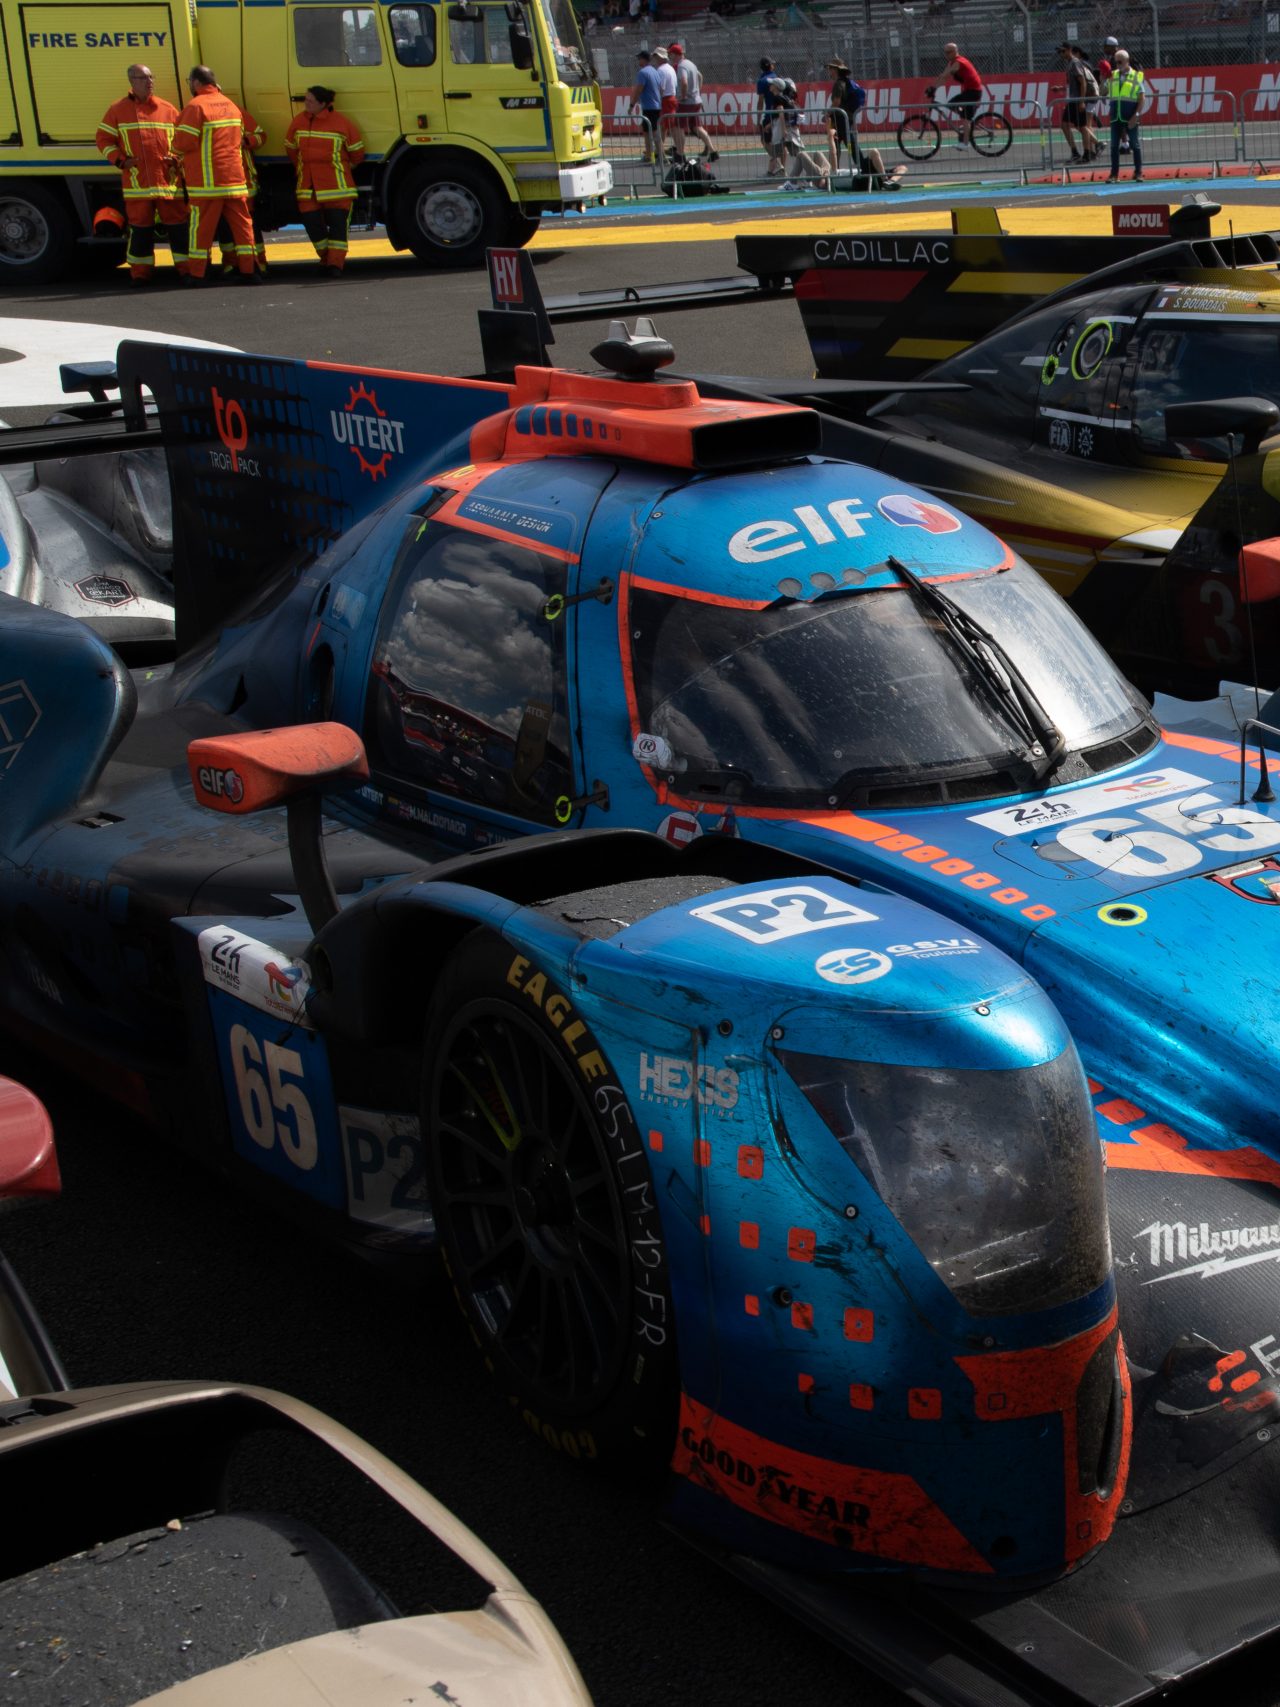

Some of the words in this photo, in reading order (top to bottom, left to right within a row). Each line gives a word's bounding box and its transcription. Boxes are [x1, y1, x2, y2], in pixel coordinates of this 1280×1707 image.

[28, 33, 78, 48] FIRE
[84, 32, 167, 47] SAFETY
[1117, 212, 1164, 228] MOTUL
[813, 239, 951, 265] CADILLAC
[492, 255, 518, 297] HY
[1182, 297, 1228, 312] BOURDAIS
[330, 408, 405, 455] UITERT
[728, 497, 874, 564] elf
[1199, 579, 1243, 665] 3
[200, 767, 224, 795] elf
[1003, 800, 1072, 823] 24h
[1017, 818, 1036, 827] LE
[1037, 808, 1079, 823] MANS
[712, 891, 857, 935] P2
[211, 935, 251, 974] 24h
[885, 938, 982, 956] GSVI
[912, 947, 980, 960] Toulouse
[220, 966, 241, 985] MANS
[506, 952, 608, 1084] EAGLE
[229, 1022, 319, 1172] 65
[638, 1051, 740, 1111] HEXIS
[346, 1123, 428, 1214] P2
[681, 1427, 872, 1529] GOODYEAR
